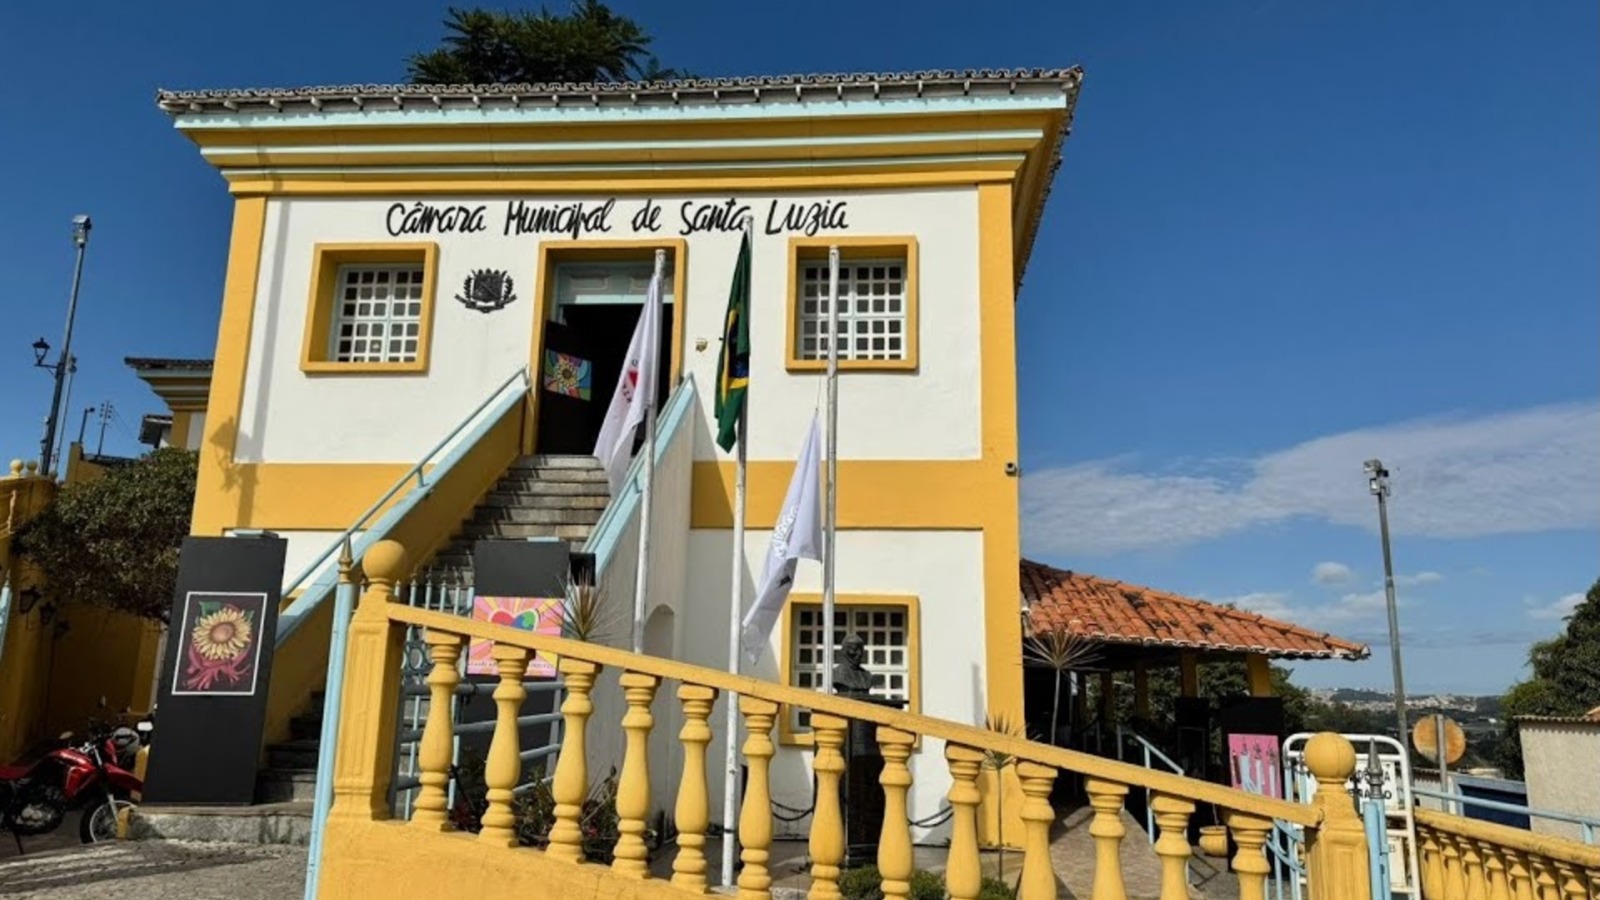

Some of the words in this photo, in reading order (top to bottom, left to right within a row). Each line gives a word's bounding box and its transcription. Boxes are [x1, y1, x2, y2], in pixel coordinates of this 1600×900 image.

[386, 201, 487, 236] Câmara
[504, 197, 616, 240] Municipal
[631, 198, 662, 232] de
[679, 198, 751, 235] Santa
[765, 199, 848, 236] Luzia
